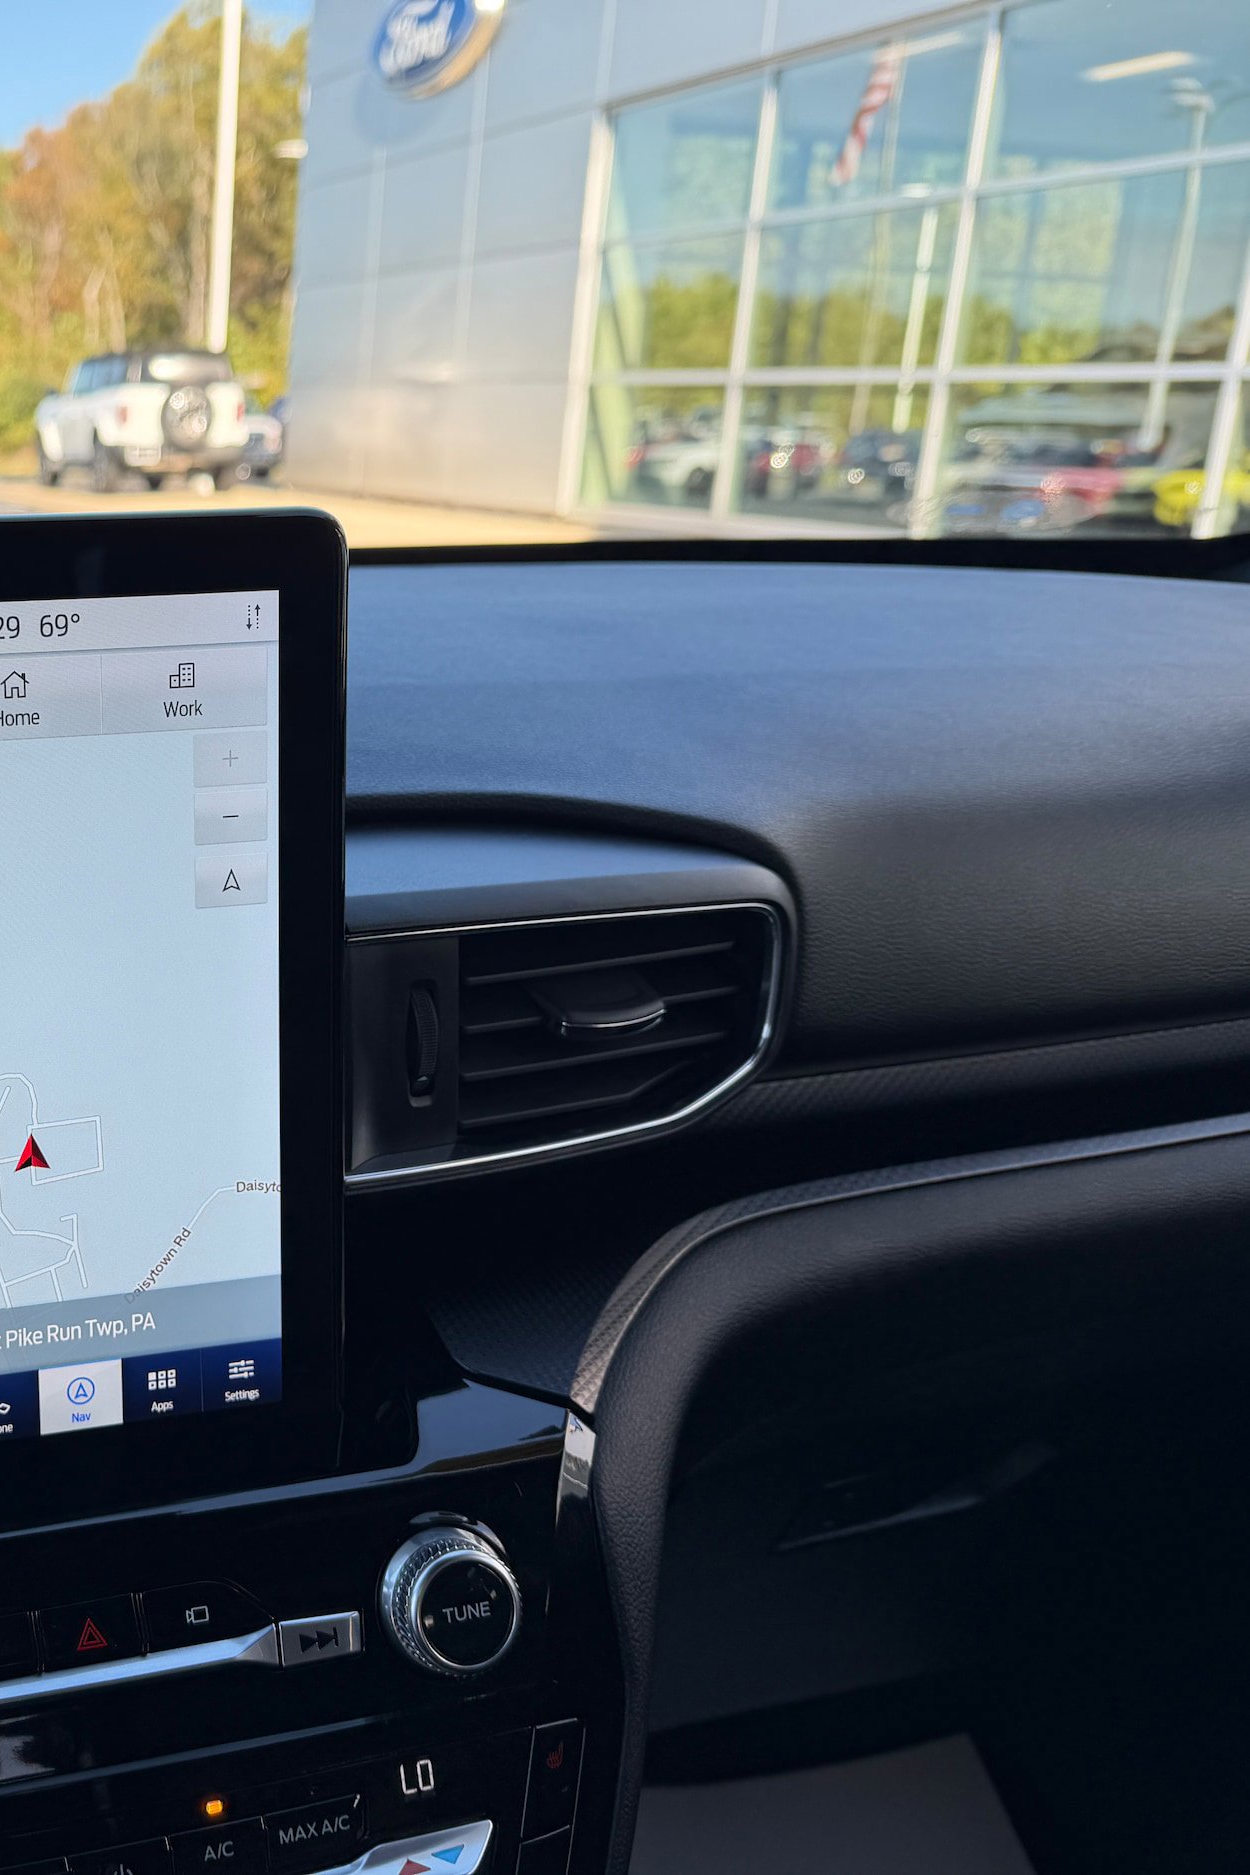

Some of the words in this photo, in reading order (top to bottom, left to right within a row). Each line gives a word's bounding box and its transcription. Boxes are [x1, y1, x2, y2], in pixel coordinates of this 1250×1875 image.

[379, 0, 455, 74] Ford
[163, 699, 203, 719] Work
[124, 1247, 178, 1304] Daisytown
[173, 1226, 192, 1248] Rd
[5, 1327, 43, 1348] Pike
[46, 1323, 82, 1343] Run
[85, 1317, 128, 1338] Twp,
[131, 1311, 156, 1332] PA
[150, 1400, 174, 1412] Apps
[224, 1388, 260, 1402] Settings
[71, 1411, 92, 1423] Nav
[442, 1601, 492, 1625] TUNE
[399, 1758, 435, 1795] LO
[278, 1822, 318, 1845] MAX
[320, 1815, 351, 1836] A/C
[204, 1841, 235, 1862] A/C
